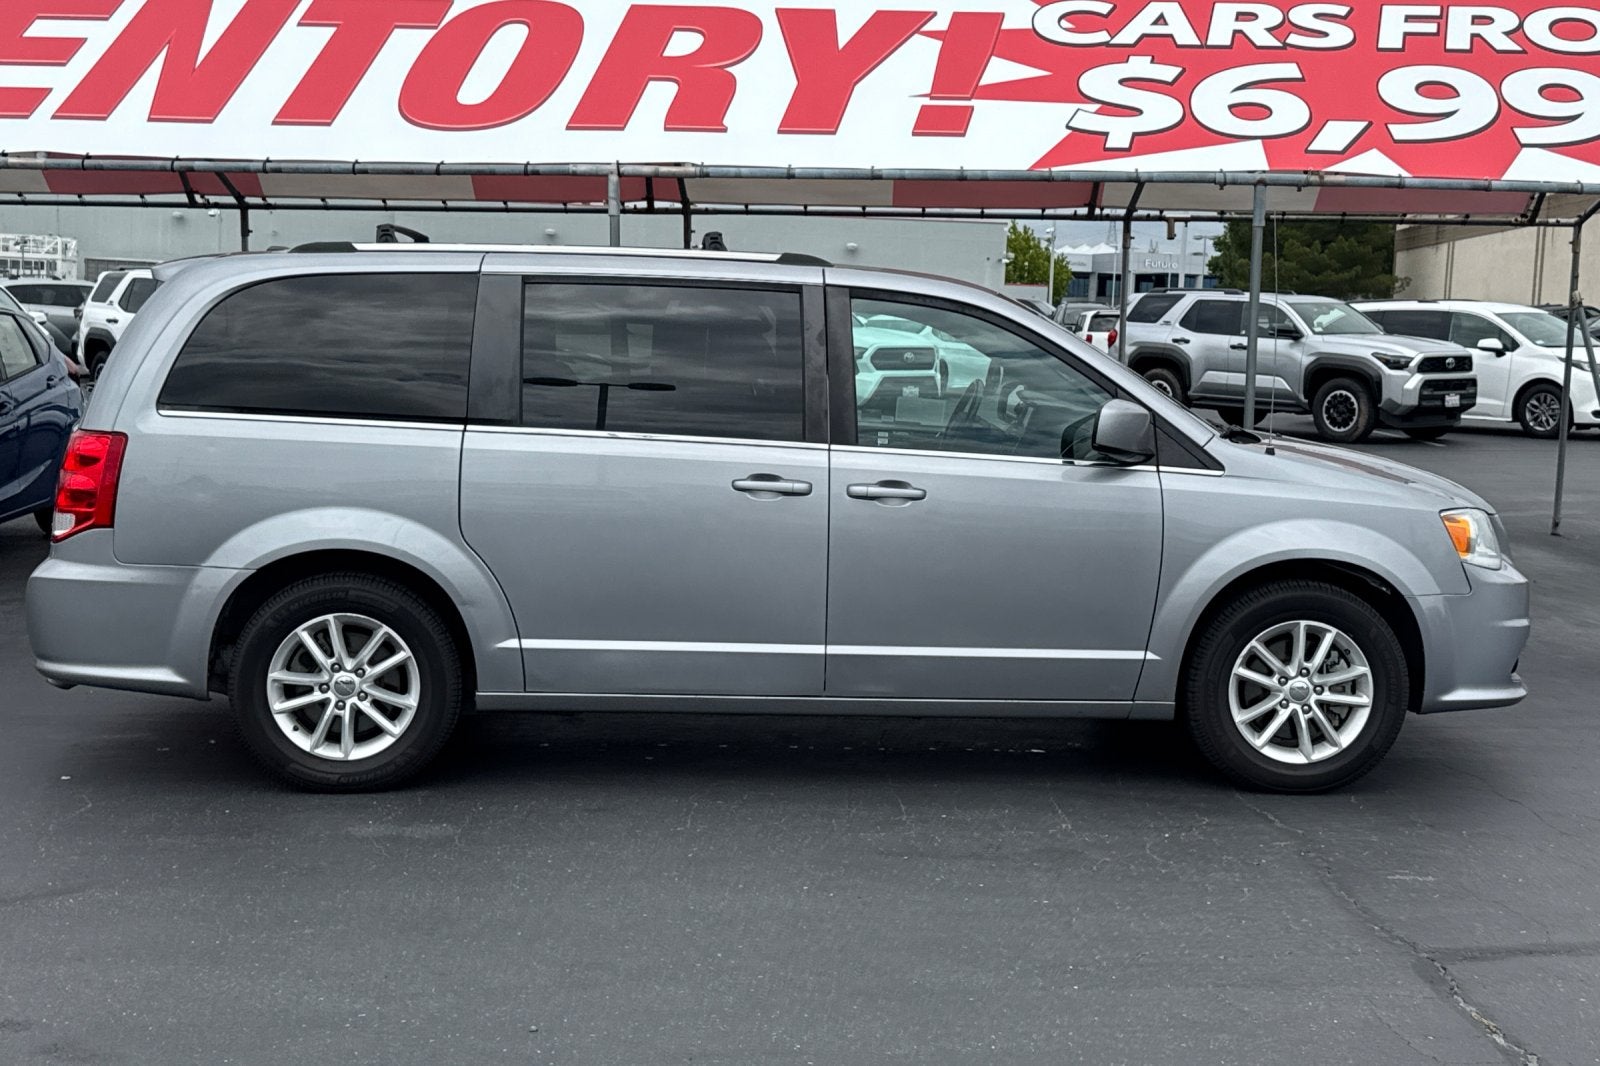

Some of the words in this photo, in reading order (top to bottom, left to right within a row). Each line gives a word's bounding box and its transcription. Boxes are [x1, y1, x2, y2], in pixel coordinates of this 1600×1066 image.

[1032, 0, 1356, 50] CARS
[1377, 3, 1600, 56] FRO
[1067, 55, 1600, 153] $6,99
